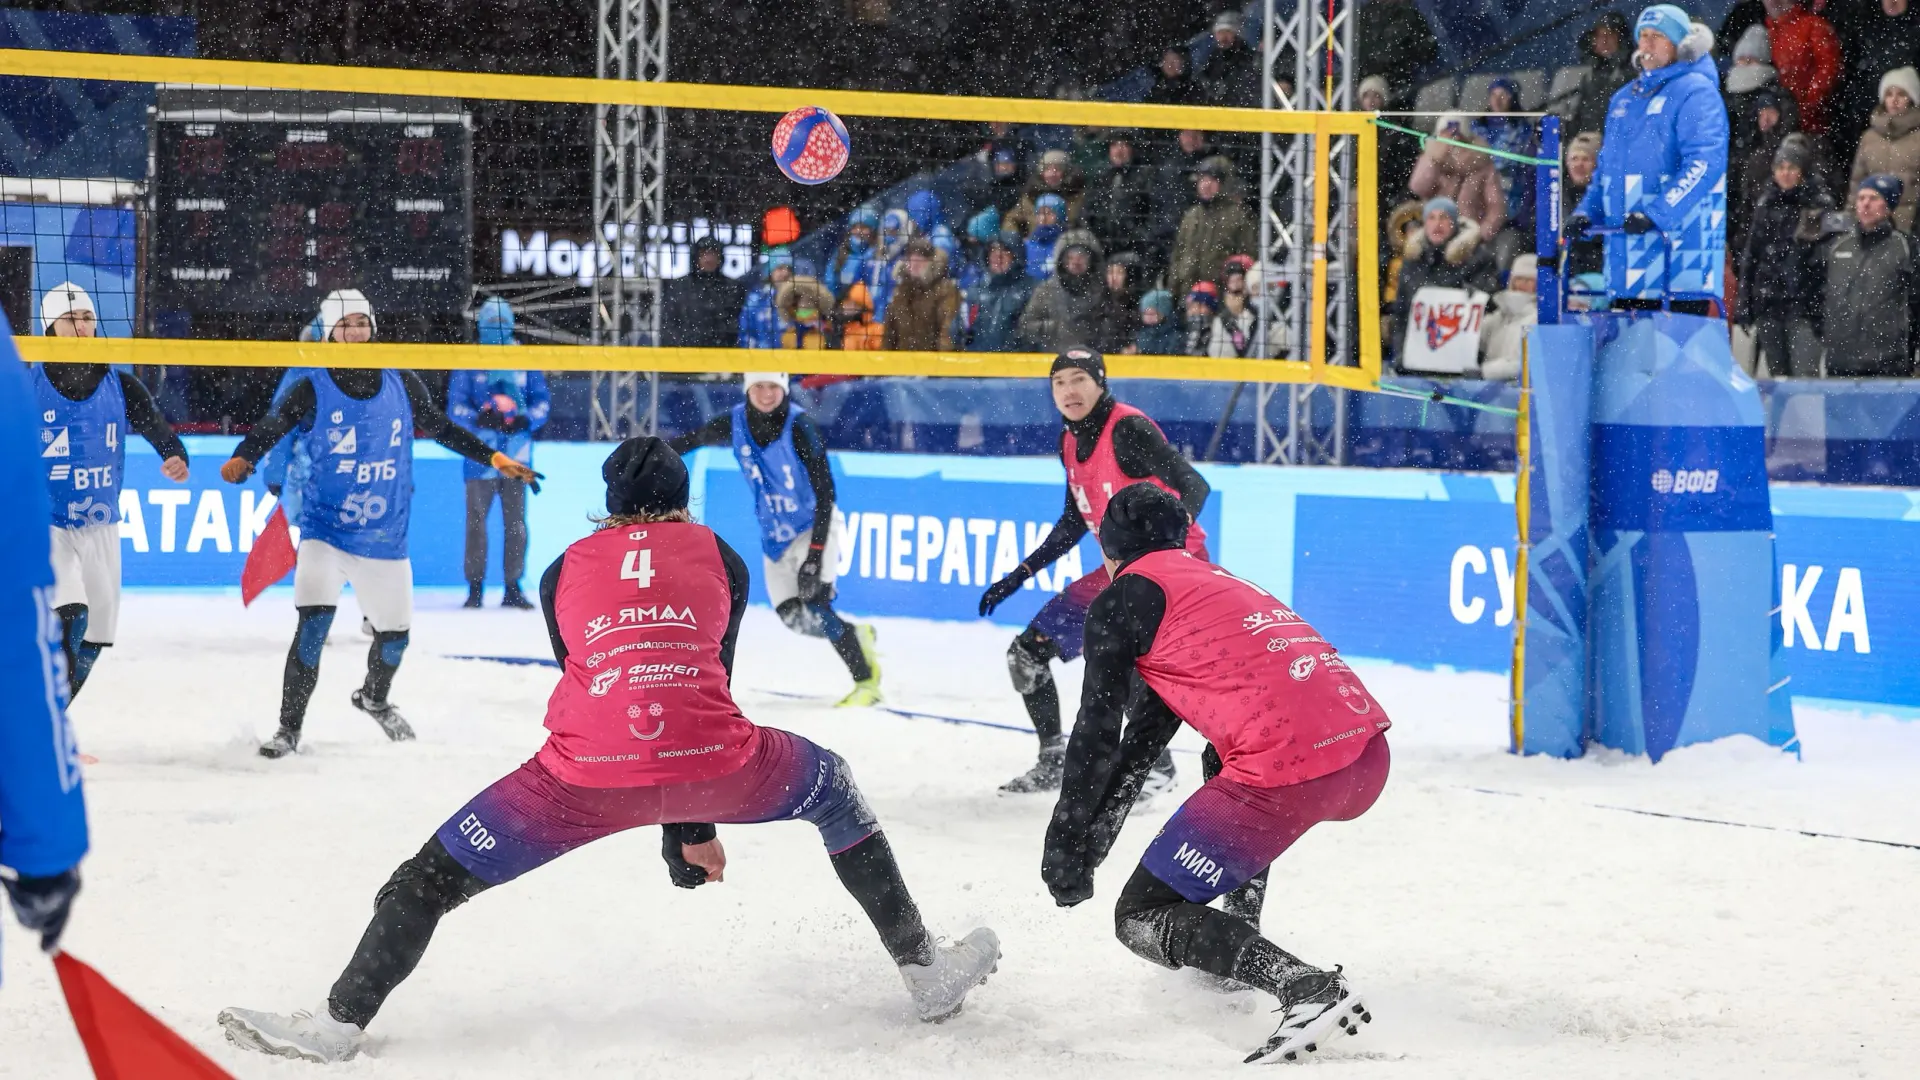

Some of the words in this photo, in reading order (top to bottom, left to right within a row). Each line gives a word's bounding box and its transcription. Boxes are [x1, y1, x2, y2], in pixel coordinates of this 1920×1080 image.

[105, 423, 117, 452] 4
[390, 418, 402, 447] 2
[357, 459, 397, 484] ВТБ
[1673, 470, 1719, 494] ВФВ
[117, 488, 300, 552] АТАК
[620, 549, 656, 588] 4
[1449, 545, 1516, 627] СУ
[618, 604, 697, 624] ЯМАЛ
[1781, 564, 1871, 653] КА
[628, 663, 699, 677] ФАКЕЛ
[628, 673, 674, 684] ЯМАЛ
[657, 743, 725, 759] SNOW.VOLLEY.RU
[1313, 726, 1367, 750] FAKELVOLLEY.RU
[458, 812, 496, 852] ЕГОР
[1173, 841, 1224, 888] МИРА
